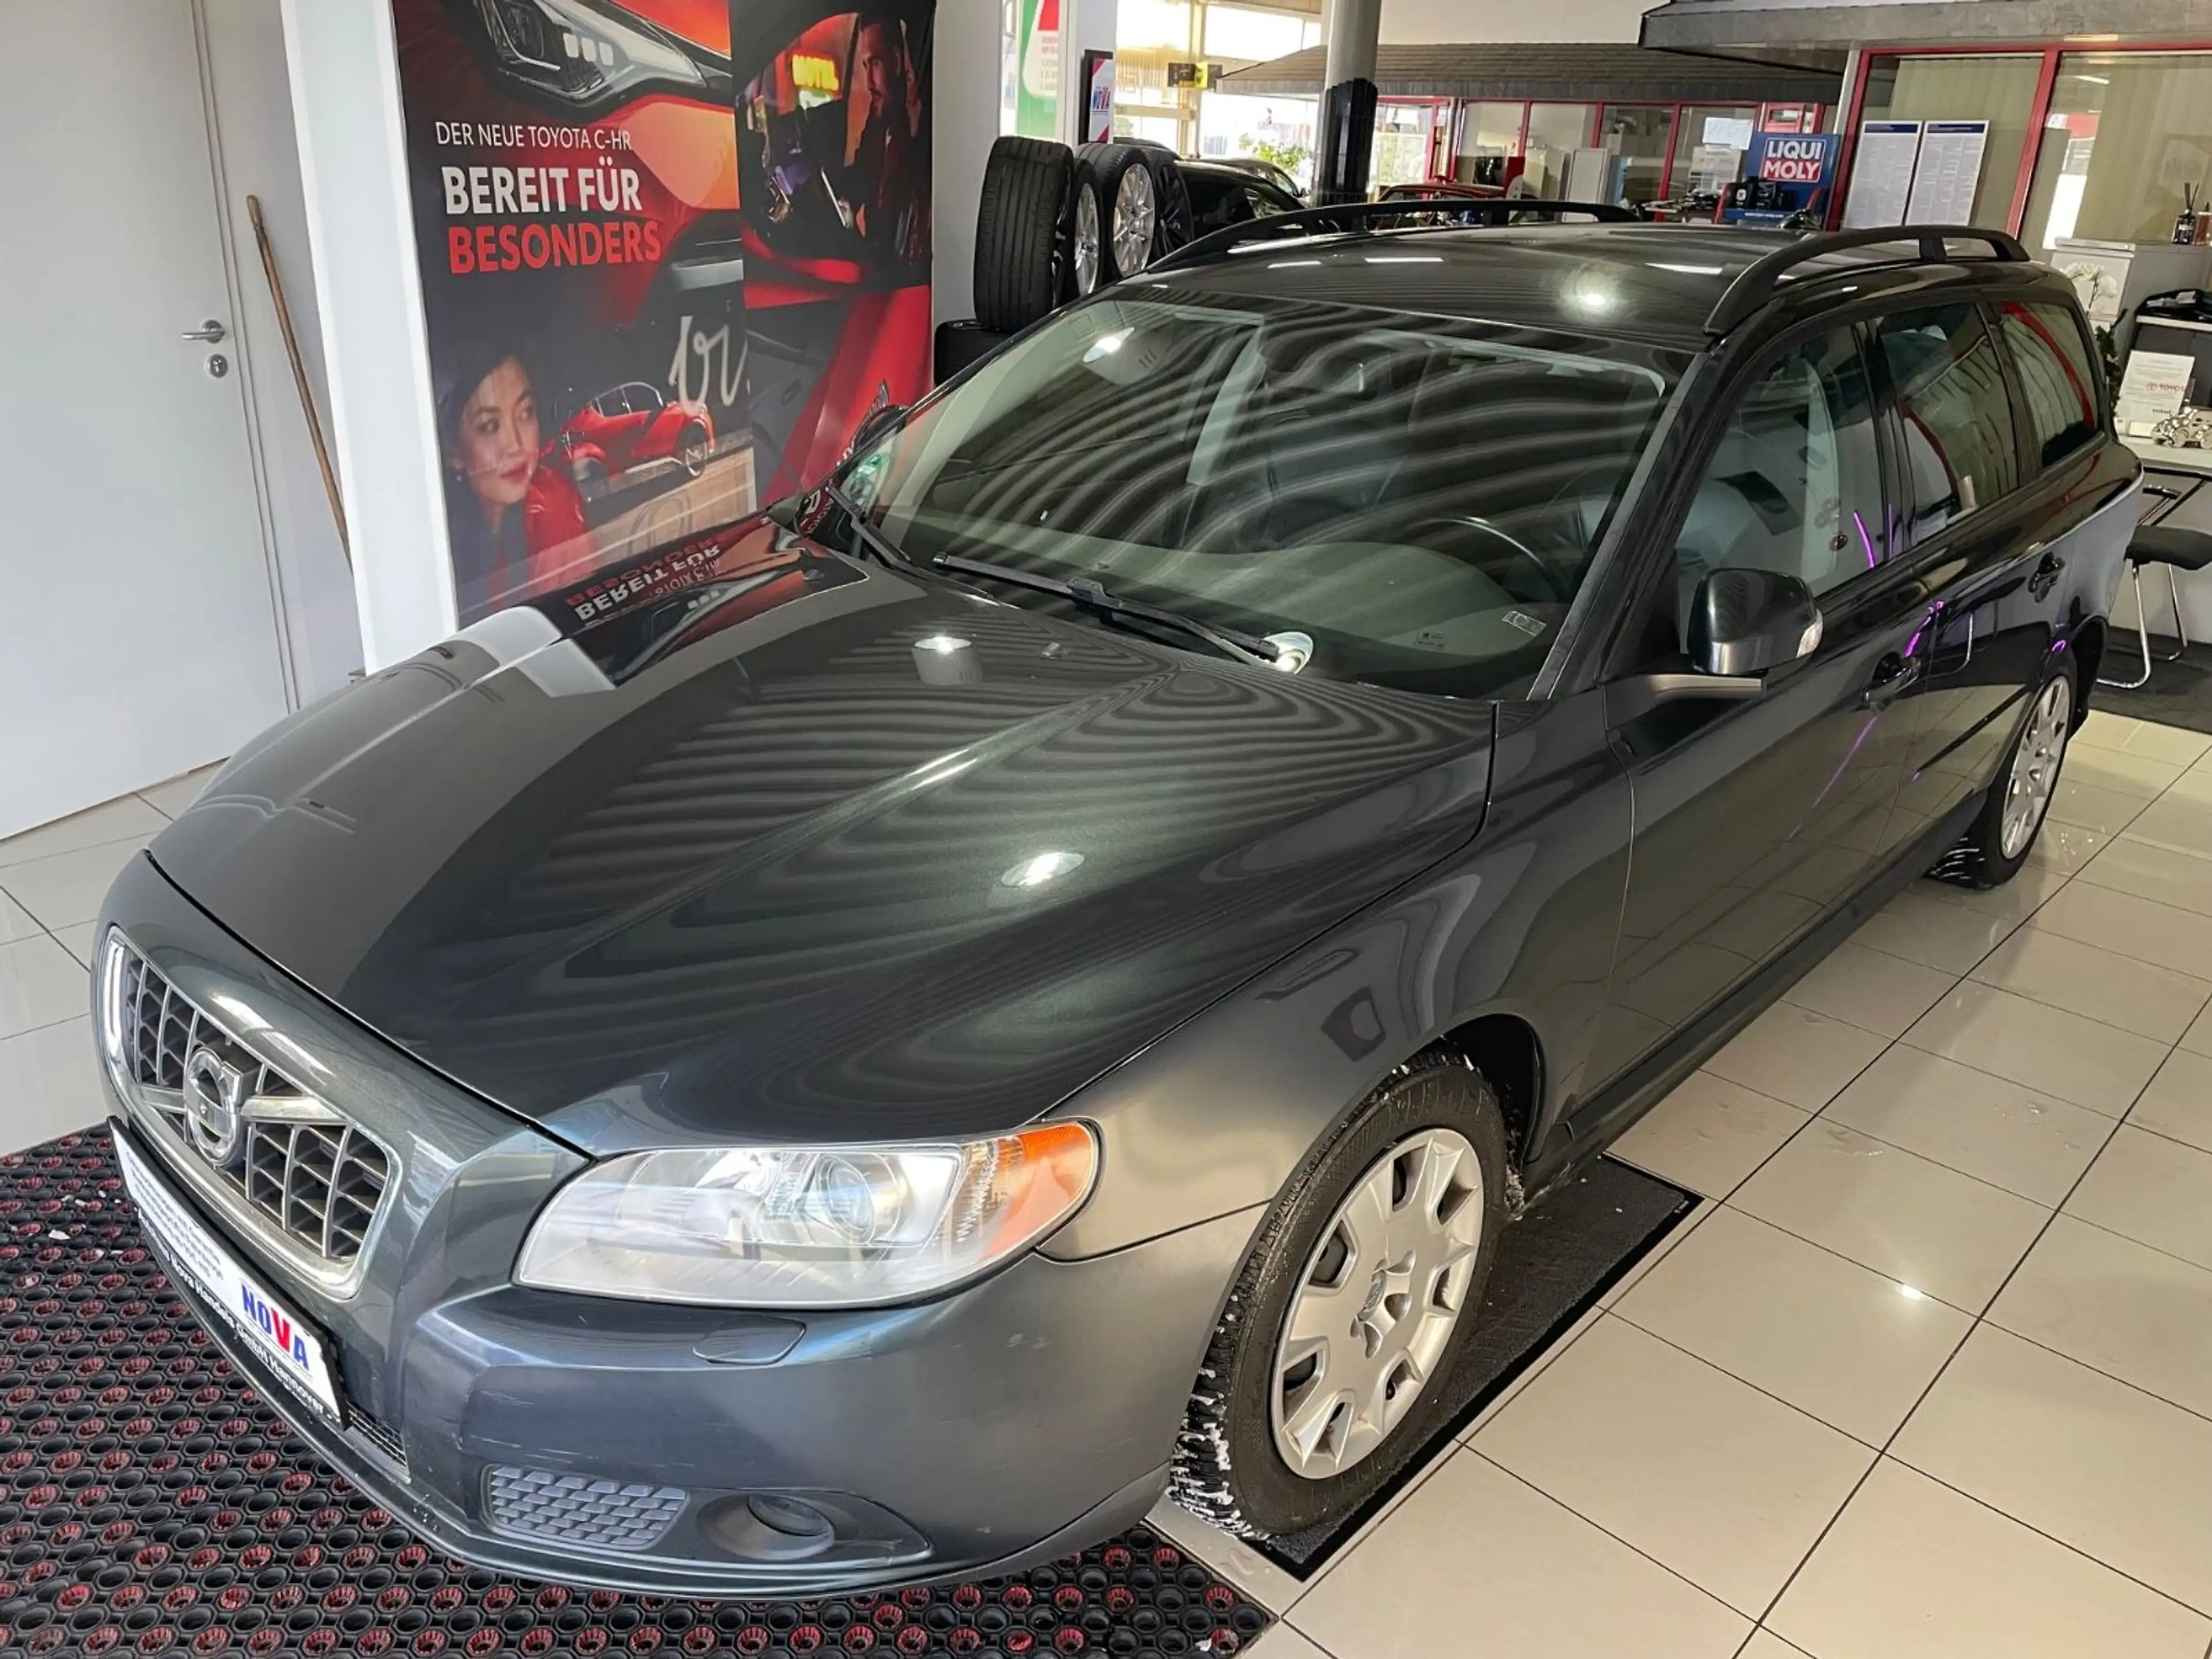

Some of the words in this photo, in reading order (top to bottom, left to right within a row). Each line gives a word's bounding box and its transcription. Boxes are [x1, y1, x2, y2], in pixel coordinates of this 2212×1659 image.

[435, 122, 474, 145] DER
[478, 123, 525, 146] NEUE
[528, 126, 591, 150] TOYOTA
[594, 129, 632, 151] C-HR
[1767, 141, 1823, 160] LIQUI
[441, 166, 569, 214] BEREIT
[577, 156, 643, 212] FÜR
[1763, 161, 1821, 180] MOLY
[448, 221, 661, 274] BESONDERS
[241, 1283, 309, 1371] NOVA
